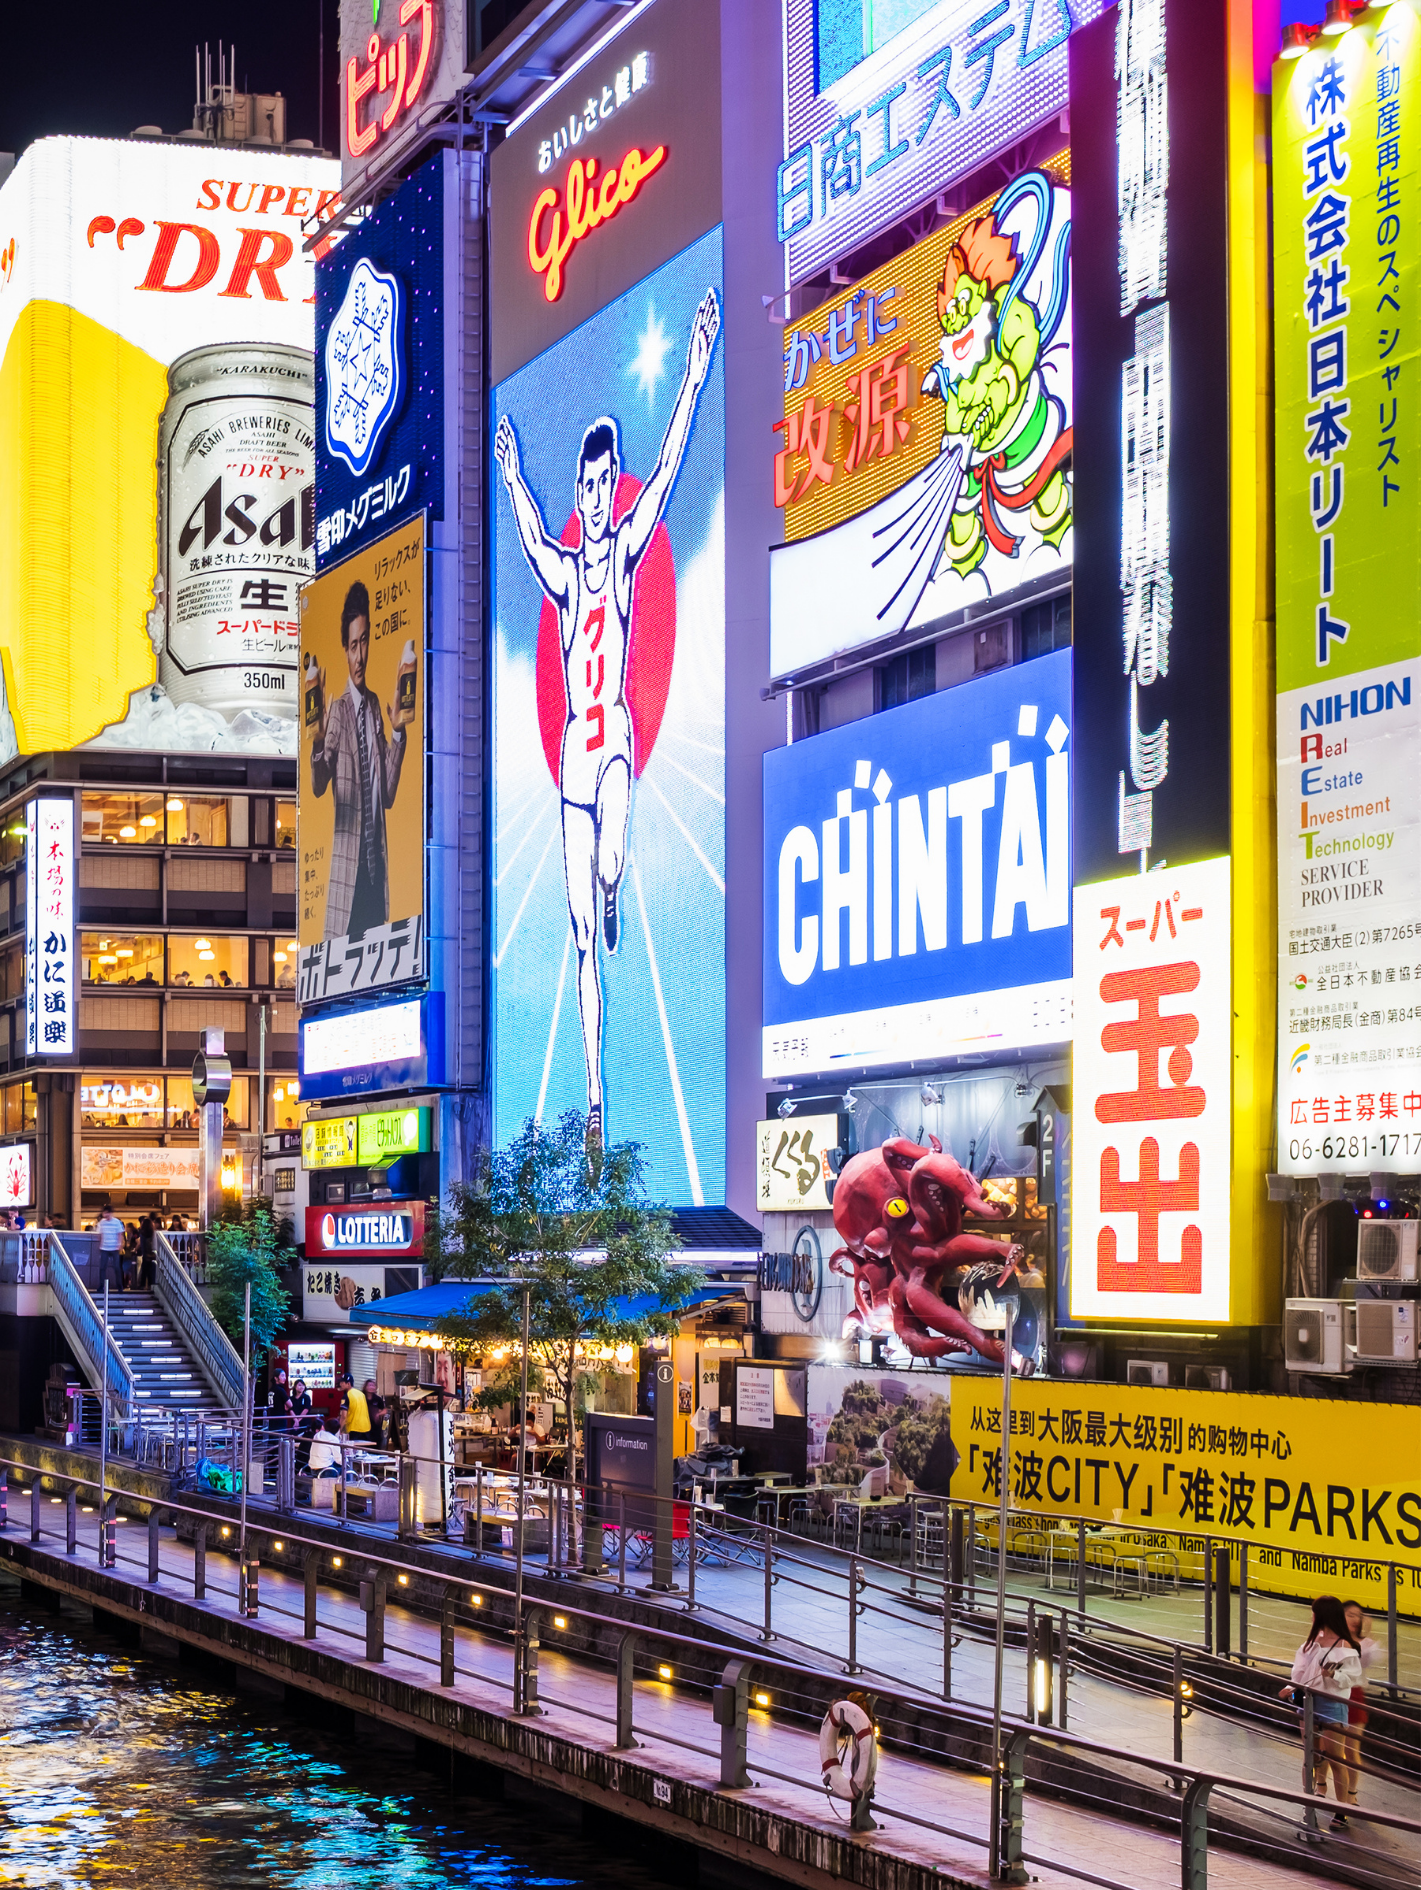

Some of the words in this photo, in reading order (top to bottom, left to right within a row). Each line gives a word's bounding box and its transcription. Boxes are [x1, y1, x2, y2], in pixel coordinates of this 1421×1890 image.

[539, 52, 651, 174] おいしさと健康
[196, 178, 343, 220] SUPER
[528, 145, 668, 302] Glico
[1376, 27, 1402, 508] 不動産再生のスペシャリスト
[784, 287, 898, 391] かぜに
[1304, 57, 1350, 666] 株式会社日本リート
[198, 428, 225, 458] ASAHI
[229, 416, 291, 434] BREWERIES
[772, 341, 911, 508] 改源
[248, 455, 280, 463] SUPER
[317, 465, 412, 555] 雪印メグミルク
[375, 537, 420, 581] リラックスが
[240, 579, 288, 612] 生
[243, 672, 285, 690] 350ml
[583, 595, 606, 752] グリコ
[1300, 677, 1411, 730] NIHON
[1300, 733, 1348, 764] Real
[1300, 766, 1363, 796] Estate
[1300, 795, 1391, 830] Investment
[778, 705, 1070, 986] CHINTAI
[1299, 828, 1395, 860] Technology
[45, 840, 65, 921] 本場の味
[1301, 858, 1370, 886] SERVICE
[1301, 879, 1385, 907] PROVIDER
[1099, 891, 1204, 951] スーパー
[43, 931, 68, 1044] かに道楽
[1095, 961, 1207, 1295] 玉出
[1289, 1091, 1421, 1125] 広告主募集中
[772, 1130, 820, 1196] くくる
[1289, 1132, 1421, 1161] 06-6281-1717
[337, 1215, 405, 1244] LOTTERIA
[307, 1271, 341, 1295] たこ焼き
[615, 1436, 648, 1450] information
[1259, 1549, 1282, 1567] and
